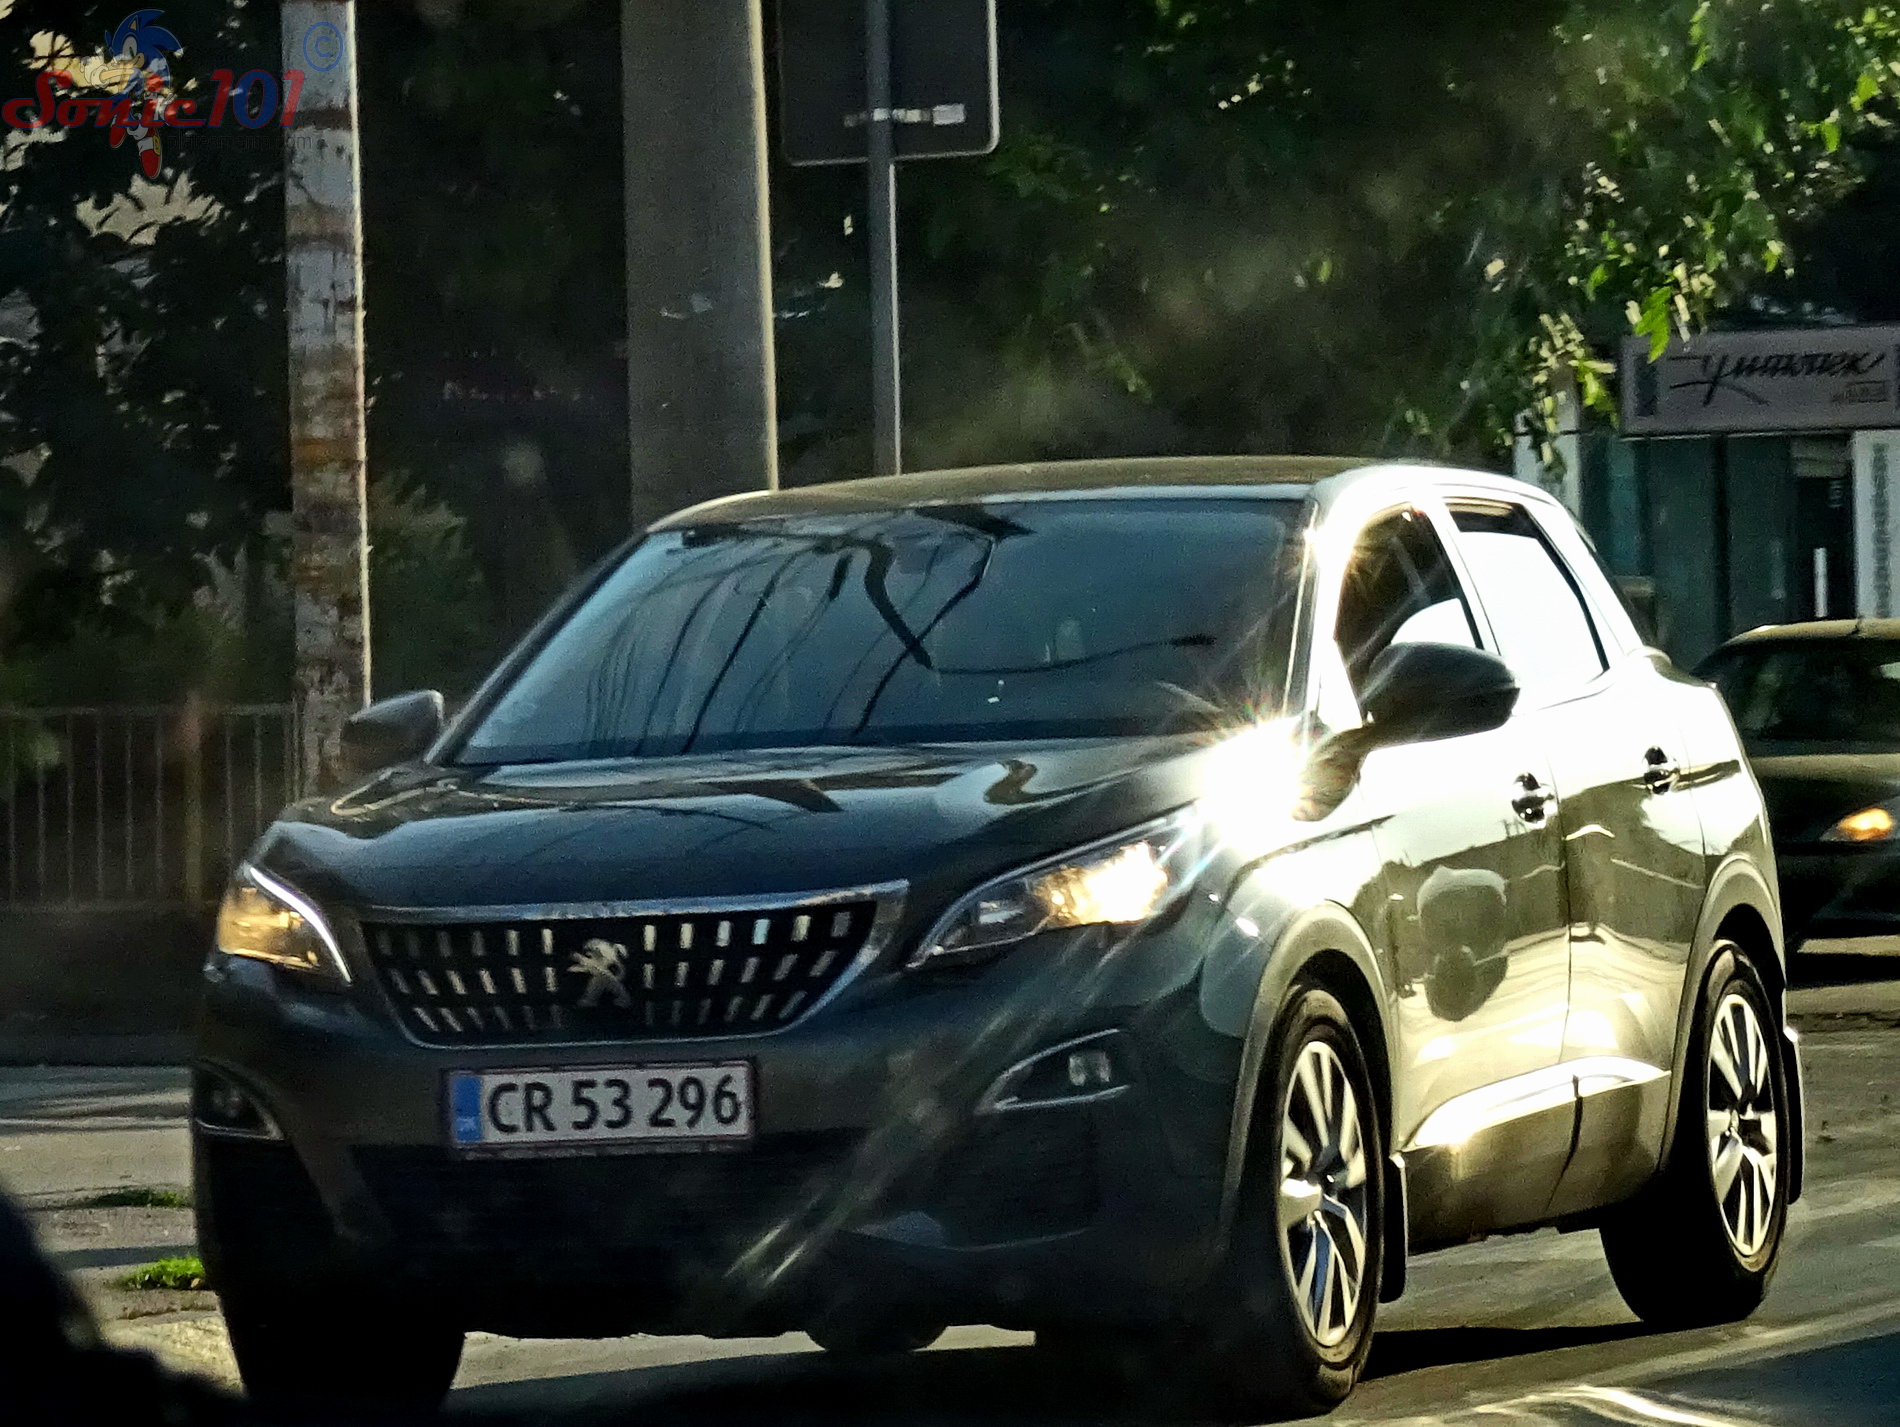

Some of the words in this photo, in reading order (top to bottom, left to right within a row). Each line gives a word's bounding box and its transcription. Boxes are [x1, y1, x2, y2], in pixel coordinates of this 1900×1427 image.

[488, 1081, 557, 1134] CR
[570, 1078, 633, 1130] 53
[648, 1074, 741, 1128] 296
